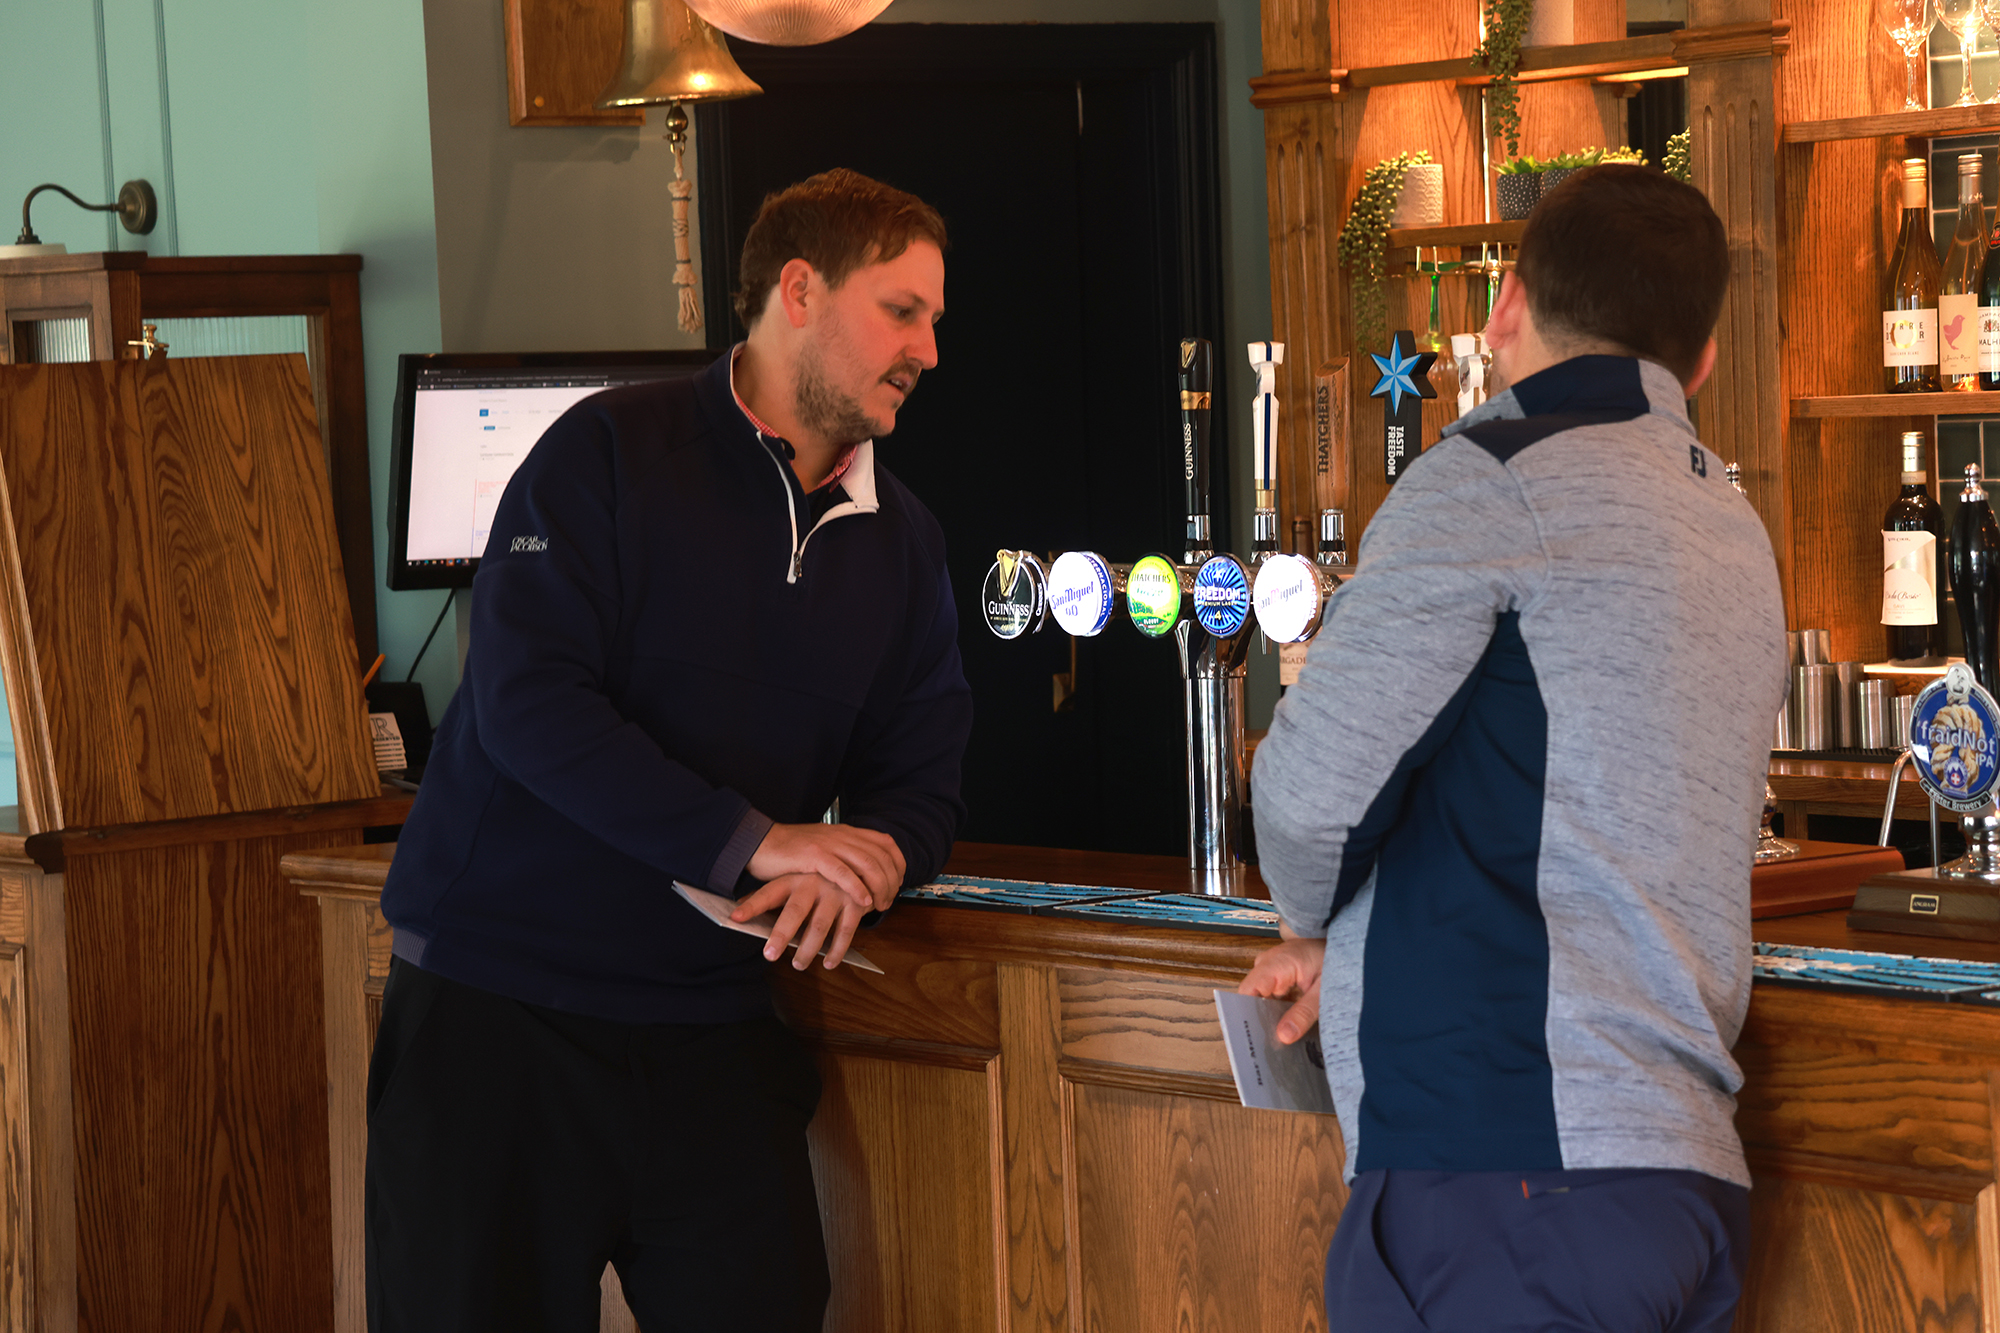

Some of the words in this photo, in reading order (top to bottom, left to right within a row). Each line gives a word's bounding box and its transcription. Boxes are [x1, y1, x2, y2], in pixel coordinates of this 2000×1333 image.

[1316, 385, 1329, 476] THATCHERS
[1396, 426, 1404, 457] TASTE
[1183, 422, 1194, 480] GUINNESS
[1387, 426, 1396, 476] FREEDOM
[512, 535, 539, 545] OSCAR
[1131, 573, 1171, 584] THATCHERS
[1194, 585, 1241, 602] FREEDOM
[988, 600, 1030, 617] GUINNESS
[1214, 610, 1222, 621] 4
[1975, 752, 1994, 769] IPA
[1952, 800, 1981, 811] Brewery
